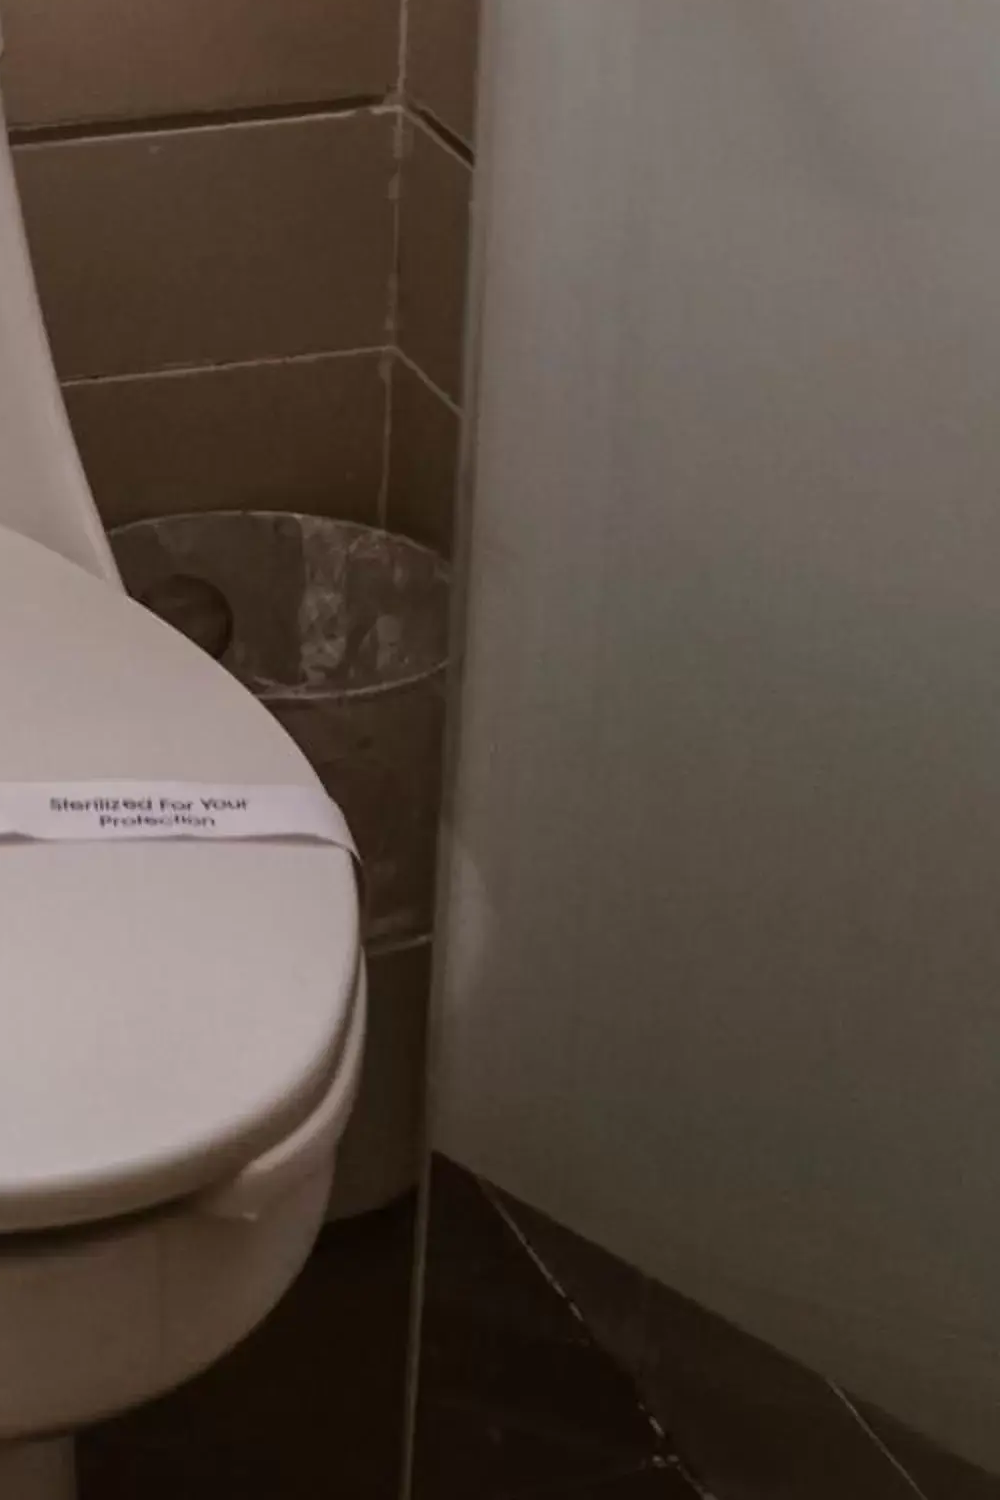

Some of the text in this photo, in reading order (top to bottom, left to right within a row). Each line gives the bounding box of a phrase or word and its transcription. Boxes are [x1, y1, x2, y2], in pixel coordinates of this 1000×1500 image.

[50, 797, 248, 812] Sterilized For Your
[98, 813, 216, 828] Protection
